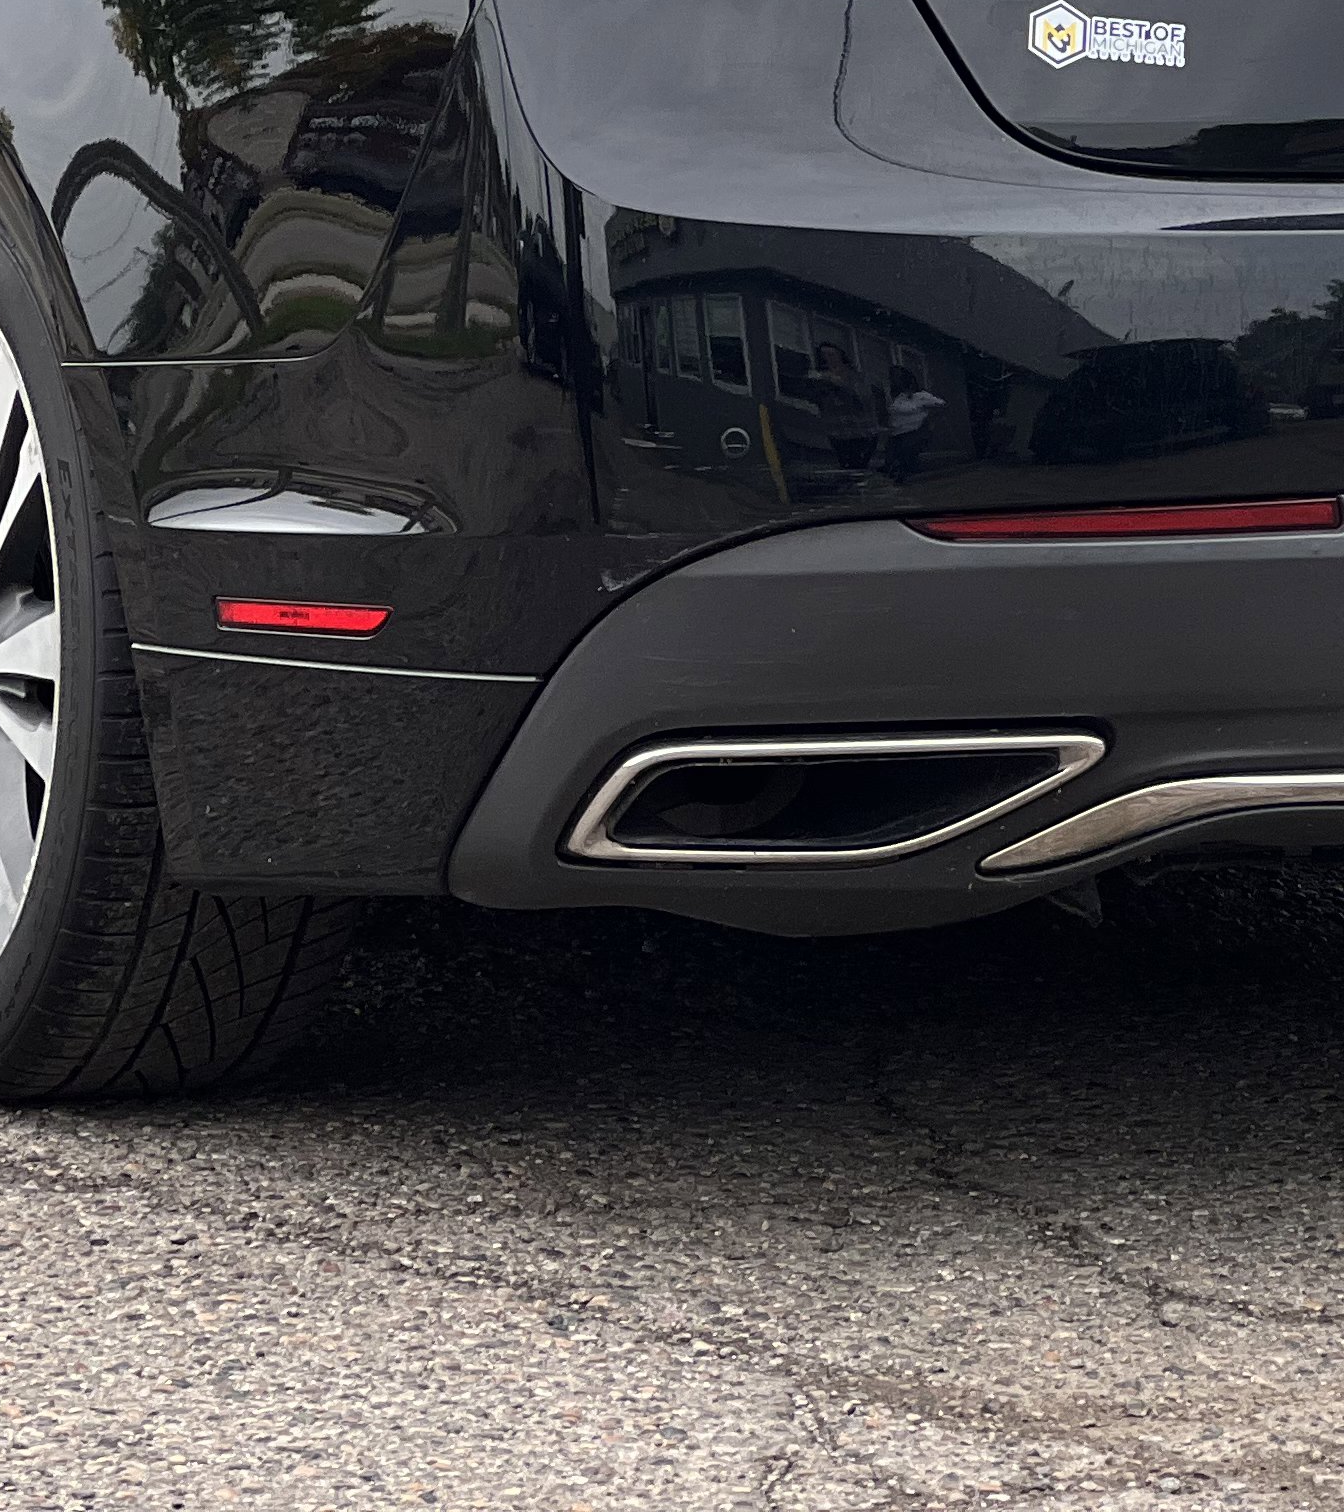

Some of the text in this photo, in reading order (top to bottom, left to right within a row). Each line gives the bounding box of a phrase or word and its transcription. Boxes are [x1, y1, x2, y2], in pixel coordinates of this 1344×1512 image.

[1094, 19, 1183, 42] BEST OF
[1092, 38, 1183, 57] MICHIGAN
